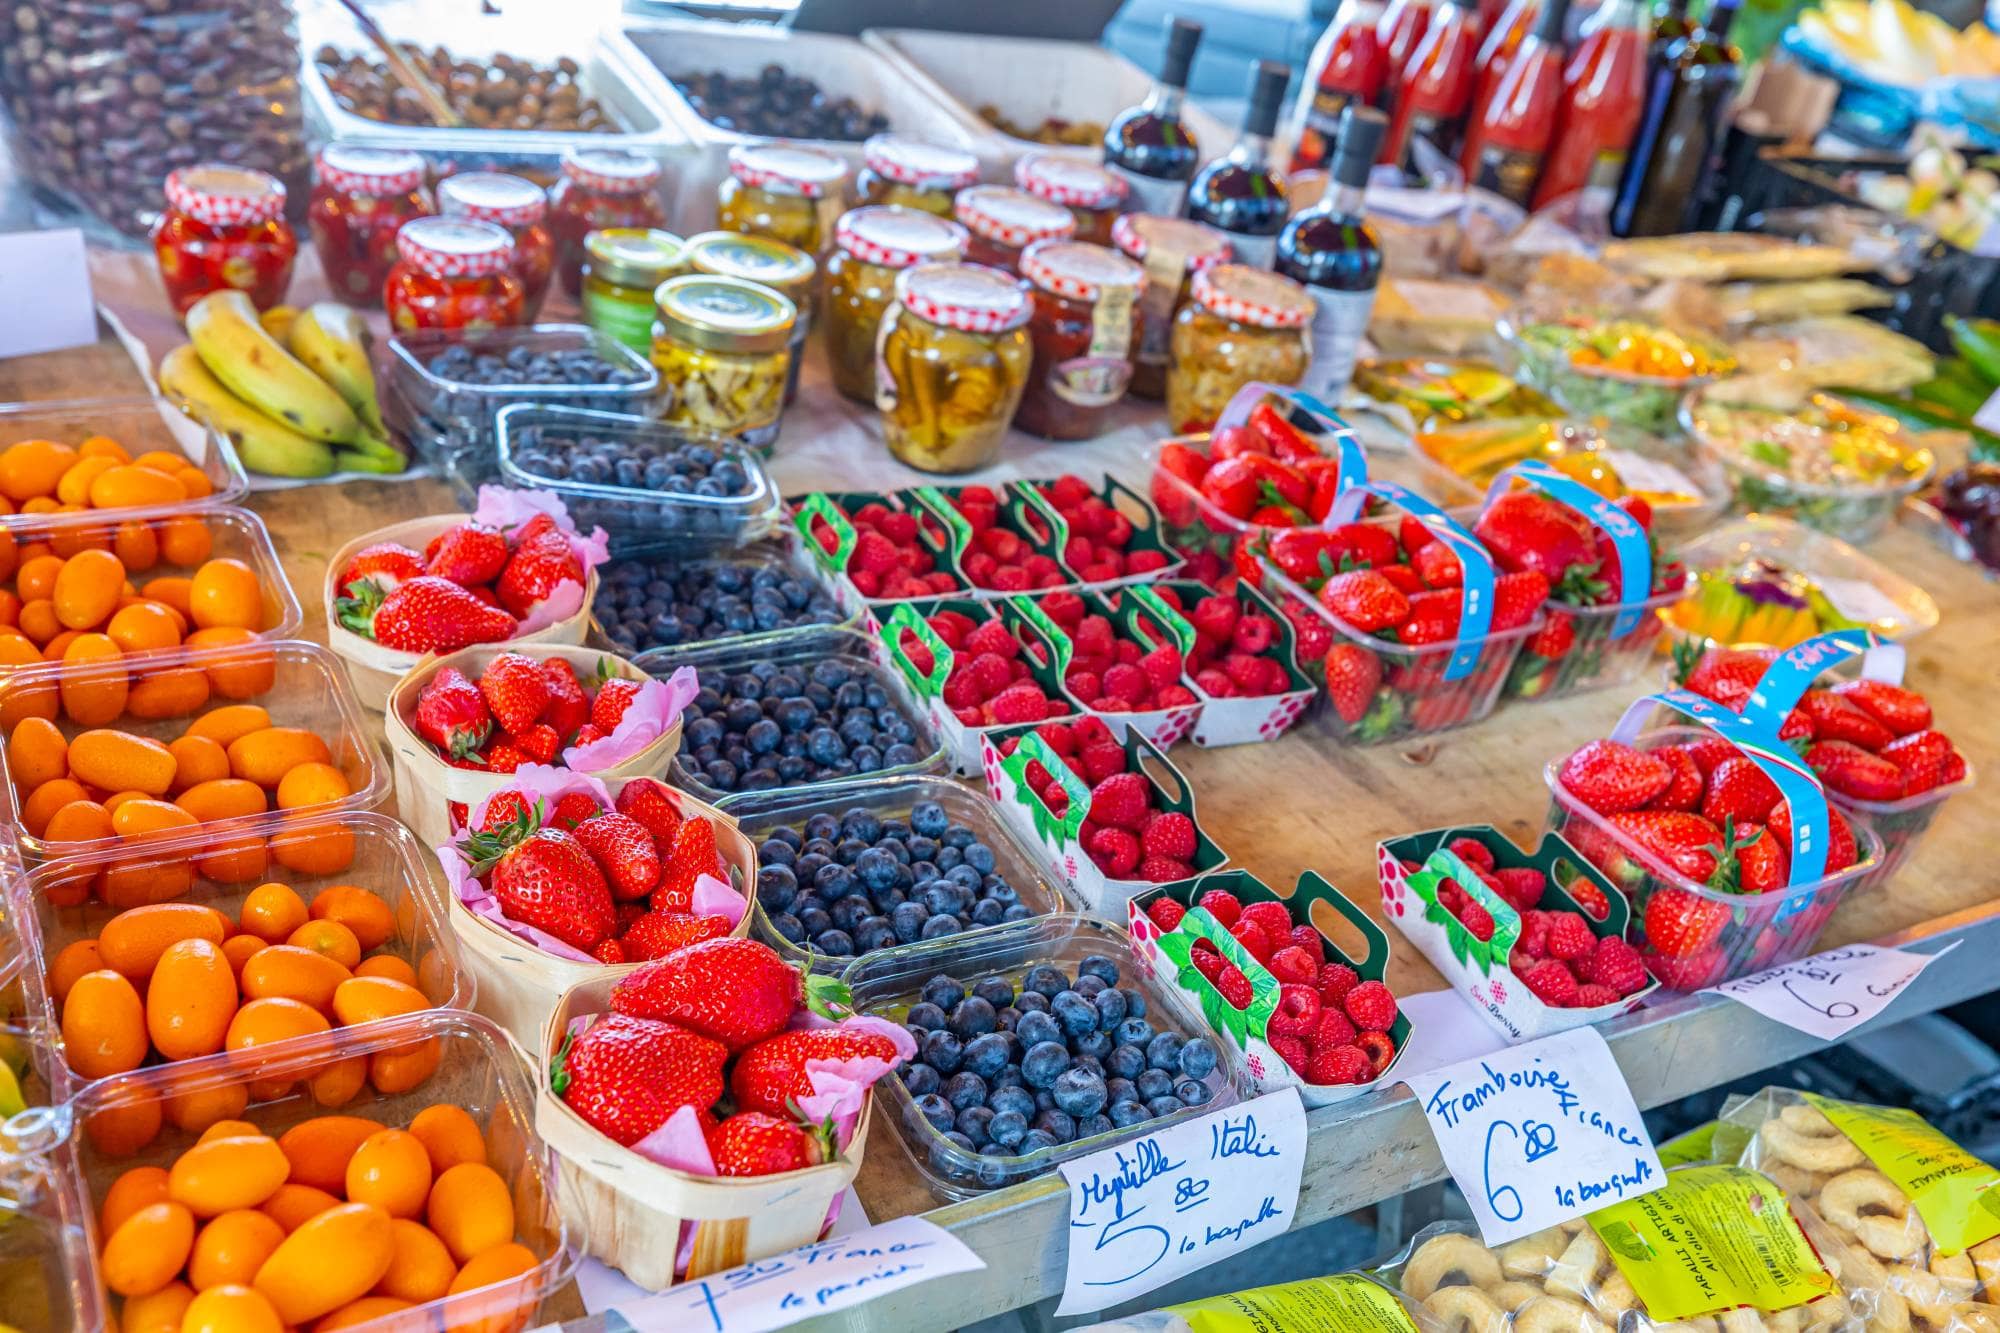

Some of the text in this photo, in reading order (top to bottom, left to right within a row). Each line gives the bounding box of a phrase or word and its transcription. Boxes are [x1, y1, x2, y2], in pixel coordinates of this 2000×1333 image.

[1470, 984, 1523, 1039] SunBerry
[1426, 1059, 1569, 1128] Framboise
[1079, 1138, 1187, 1218] Myrtille
[1484, 1119, 1558, 1222] 6 80
[1083, 1177, 1211, 1285] 5 80
[1671, 1213, 1685, 1225] di
[1675, 1247, 1717, 1301] TARALLI
[1684, 1230, 1718, 1272] All'olio
